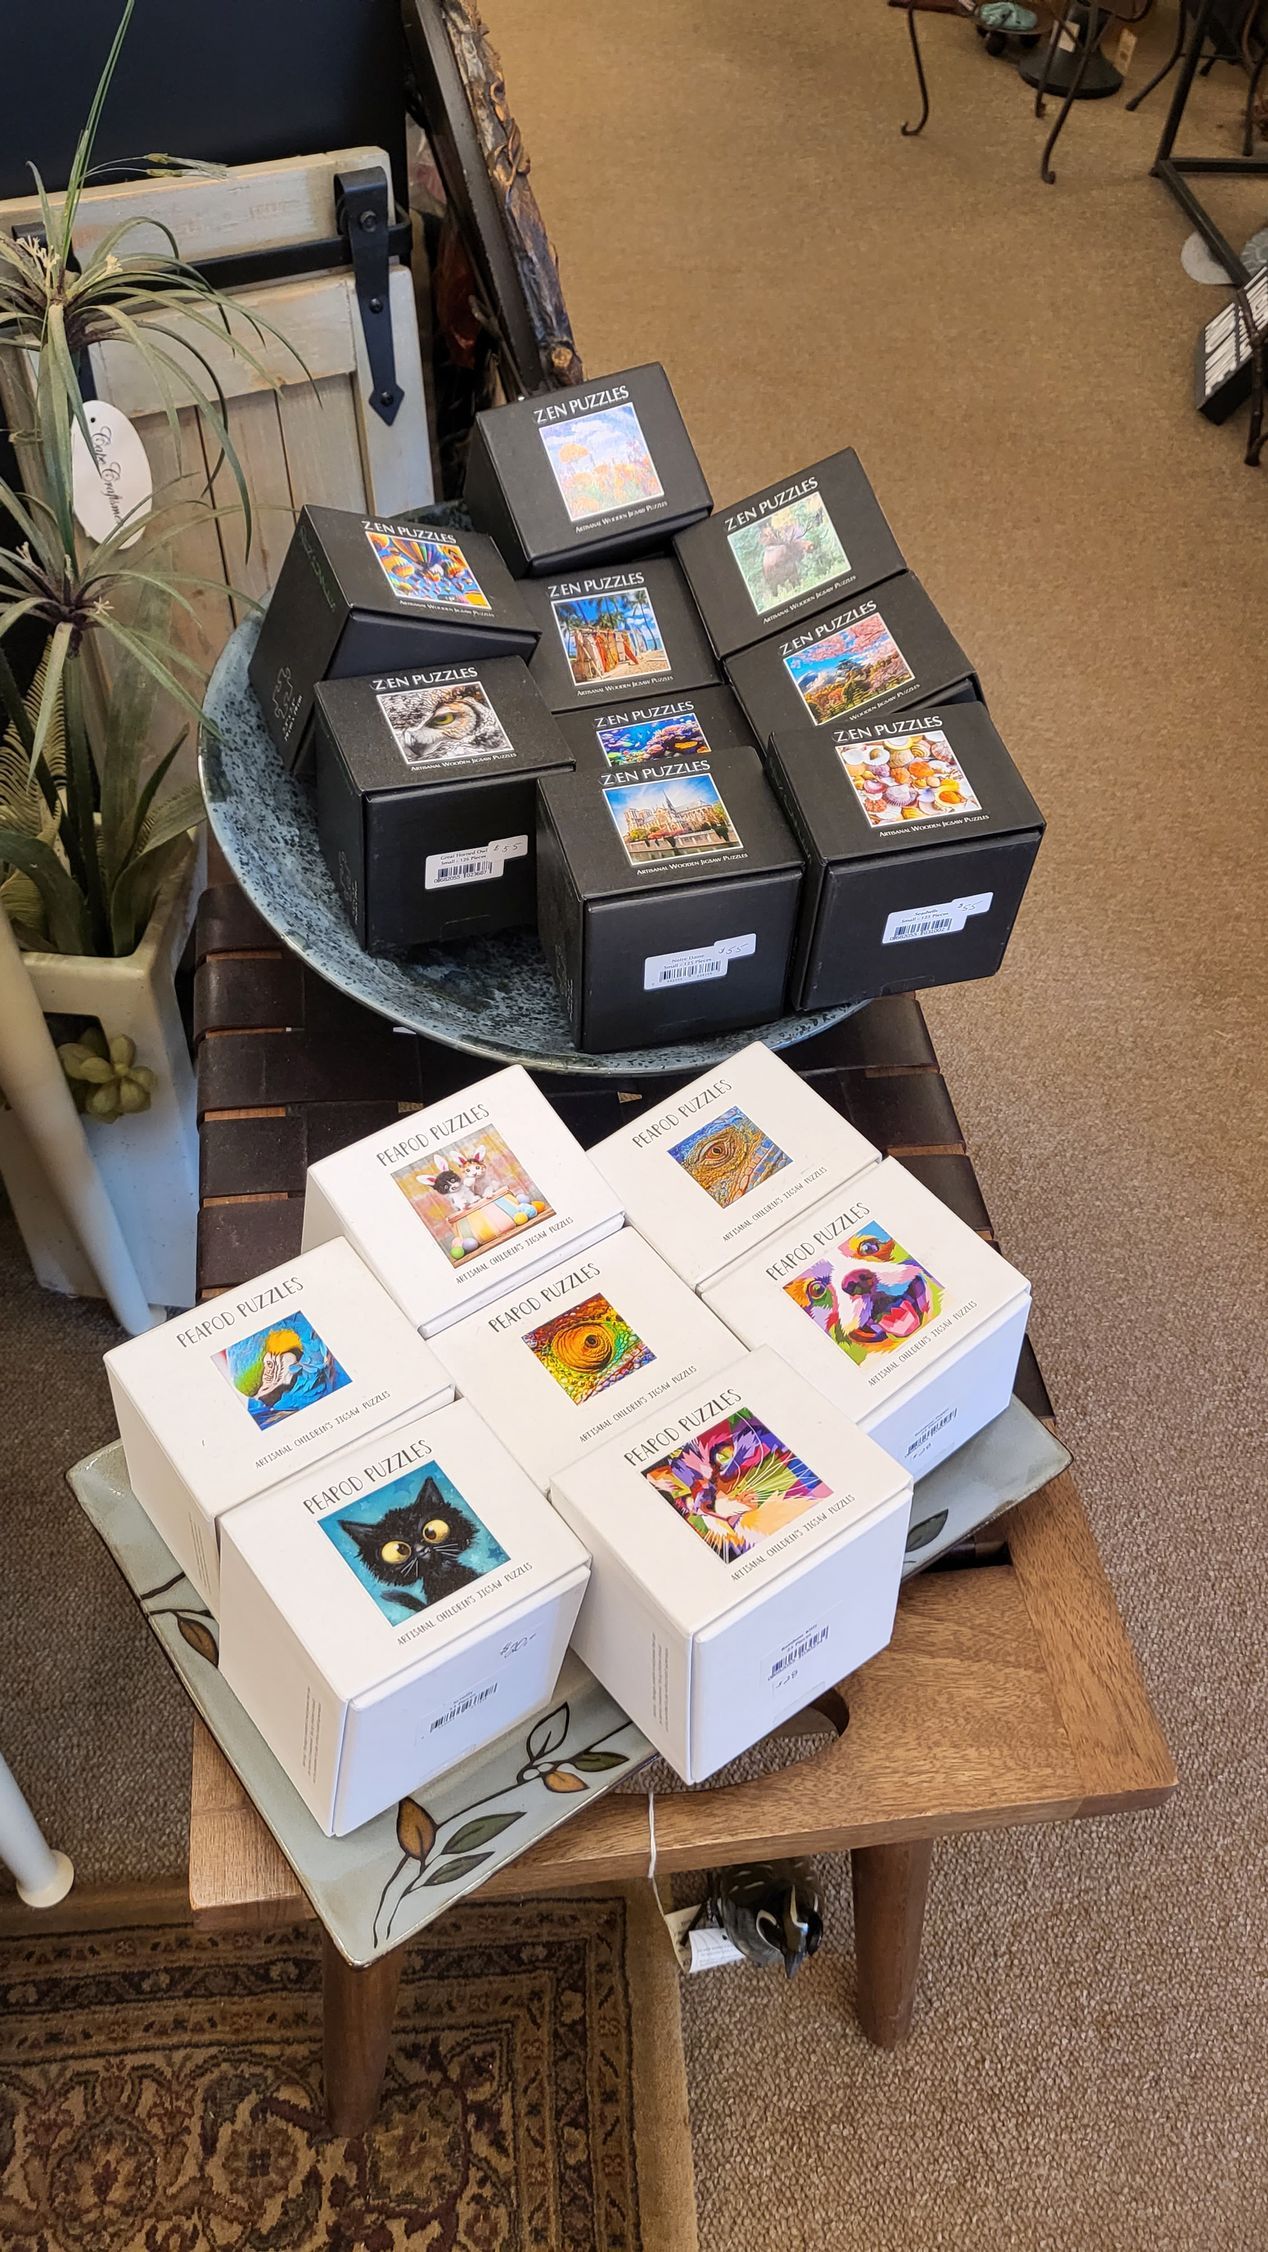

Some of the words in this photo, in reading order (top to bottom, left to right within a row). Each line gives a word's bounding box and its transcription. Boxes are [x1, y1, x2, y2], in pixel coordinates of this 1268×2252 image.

[534, 402, 567, 425] ZEN
[570, 385, 630, 416] PUZZLES
[91, 425, 112, 465] Cape
[101, 462, 122, 525] Craftsme
[725, 507, 757, 531] ZEN
[759, 477, 819, 514] PUZZLES
[361, 520, 394, 535] ZEN
[397, 526, 456, 544] PUZZLES
[547, 581, 580, 598] ZEN
[584, 572, 645, 592] PUZZLES
[779, 632, 813, 656] ZEN
[815, 600, 877, 638] PUZZLES
[372, 676, 409, 691] ZEN
[412, 667, 478, 685] PUZZLES
[594, 712, 629, 728] ZEN
[632, 700, 694, 721] PUZZLES
[834, 727, 872, 743] ZEN
[875, 715, 943, 736] PUZZLES
[601, 771, 638, 786] ZEN
[642, 760, 711, 780] PUZZLES
[376, 1133, 429, 1167] PEAPOD
[429, 1103, 490, 1140] PUZZLES
[632, 1114, 680, 1148] PEAPOD
[678, 1079, 733, 1118] PUZZLES
[765, 1242, 816, 1281] PEAPOD
[812, 1202, 870, 1247] PUZZLES
[176, 1311, 236, 1348] PEAPOD
[236, 1276, 304, 1318] PUZZLES
[488, 1297, 542, 1333] PEAPOD
[540, 1262, 600, 1302] PUZZLES
[623, 1427, 680, 1467] PEAPOD
[678, 1388, 742, 1432] PUZZLES
[303, 1476, 363, 1515] PEAPOD
[363, 1439, 433, 1483] PUZZLES
